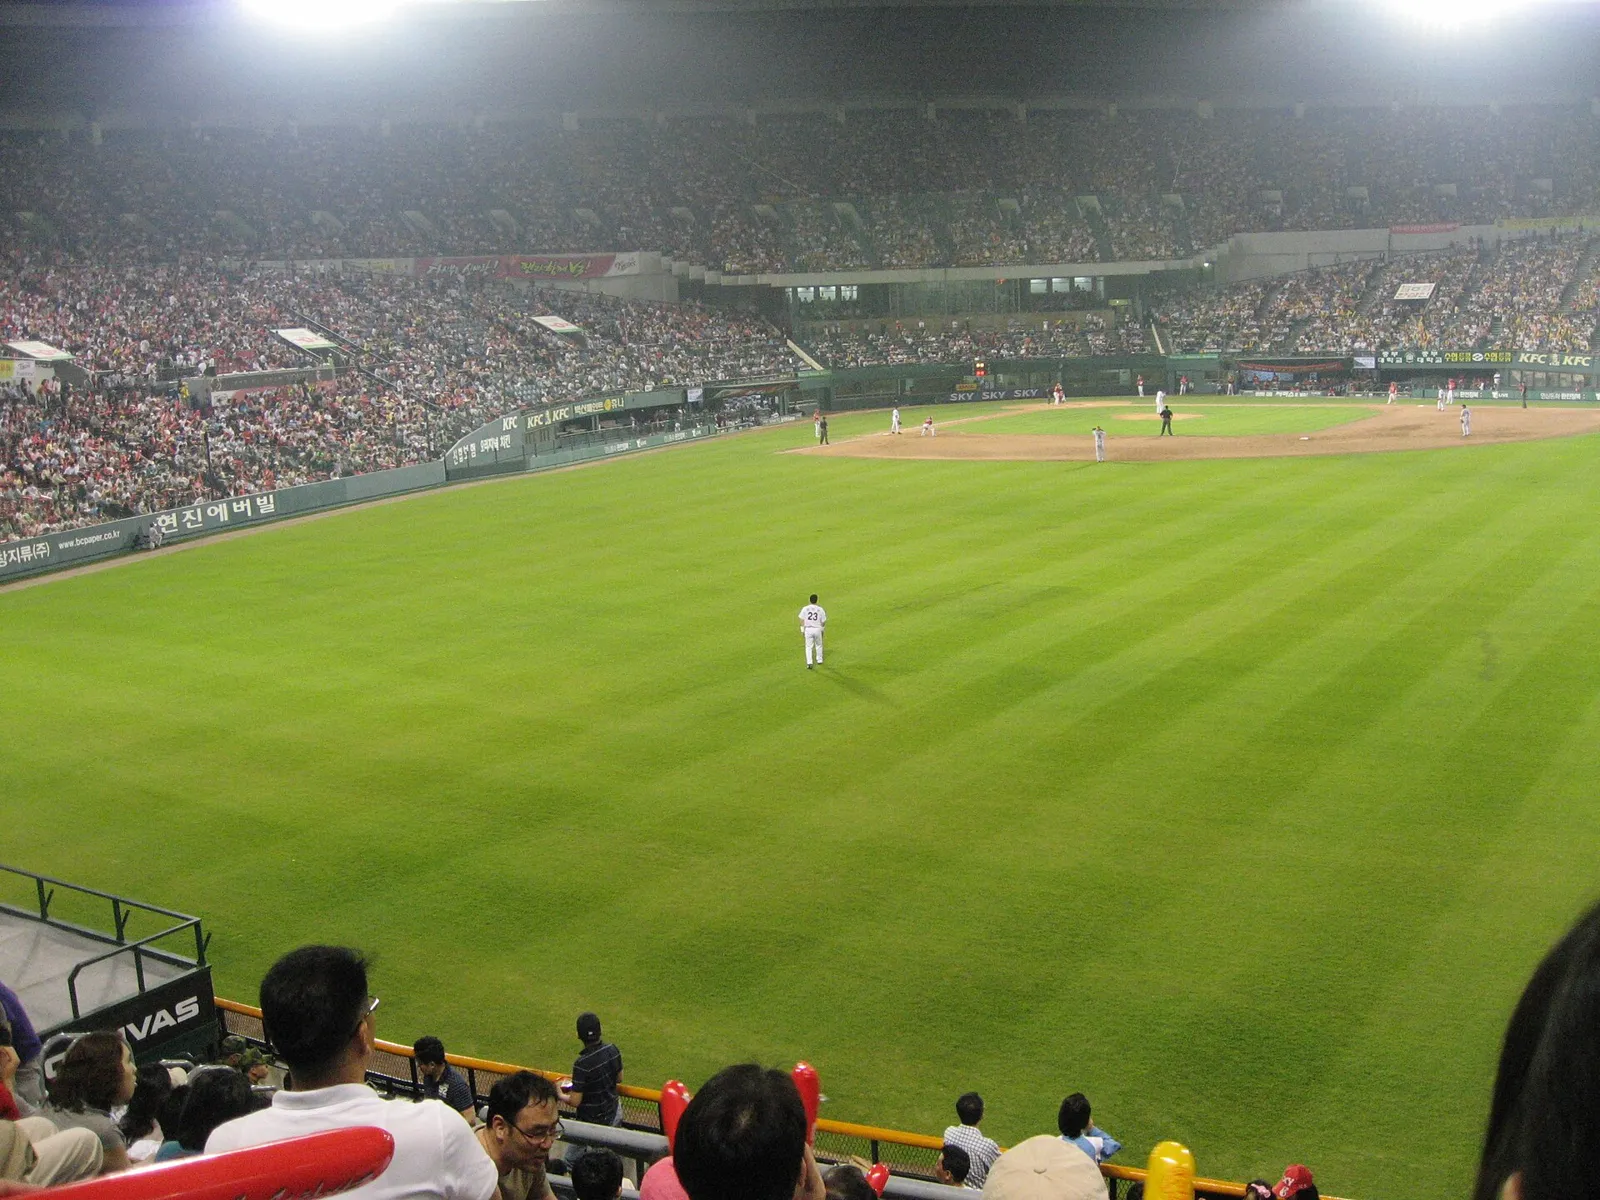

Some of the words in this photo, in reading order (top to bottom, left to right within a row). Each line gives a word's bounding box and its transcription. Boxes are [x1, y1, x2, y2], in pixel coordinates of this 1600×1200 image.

[1519, 353, 1547, 364] KFC
[1562, 355, 1591, 366] KFC
[950, 392, 974, 401] SKY
[982, 391, 1006, 400] SKY
[1014, 389, 1038, 398] SKY
[502, 415, 518, 431] KFC
[527, 413, 544, 429] KFC
[552, 407, 569, 421] KFC
[155, 493, 276, 535] 현진에버빌
[58, 530, 121, 550] www.bcpaper.co.kr
[807, 611, 818, 621] 23
[44, 995, 200, 1080] CVAS
